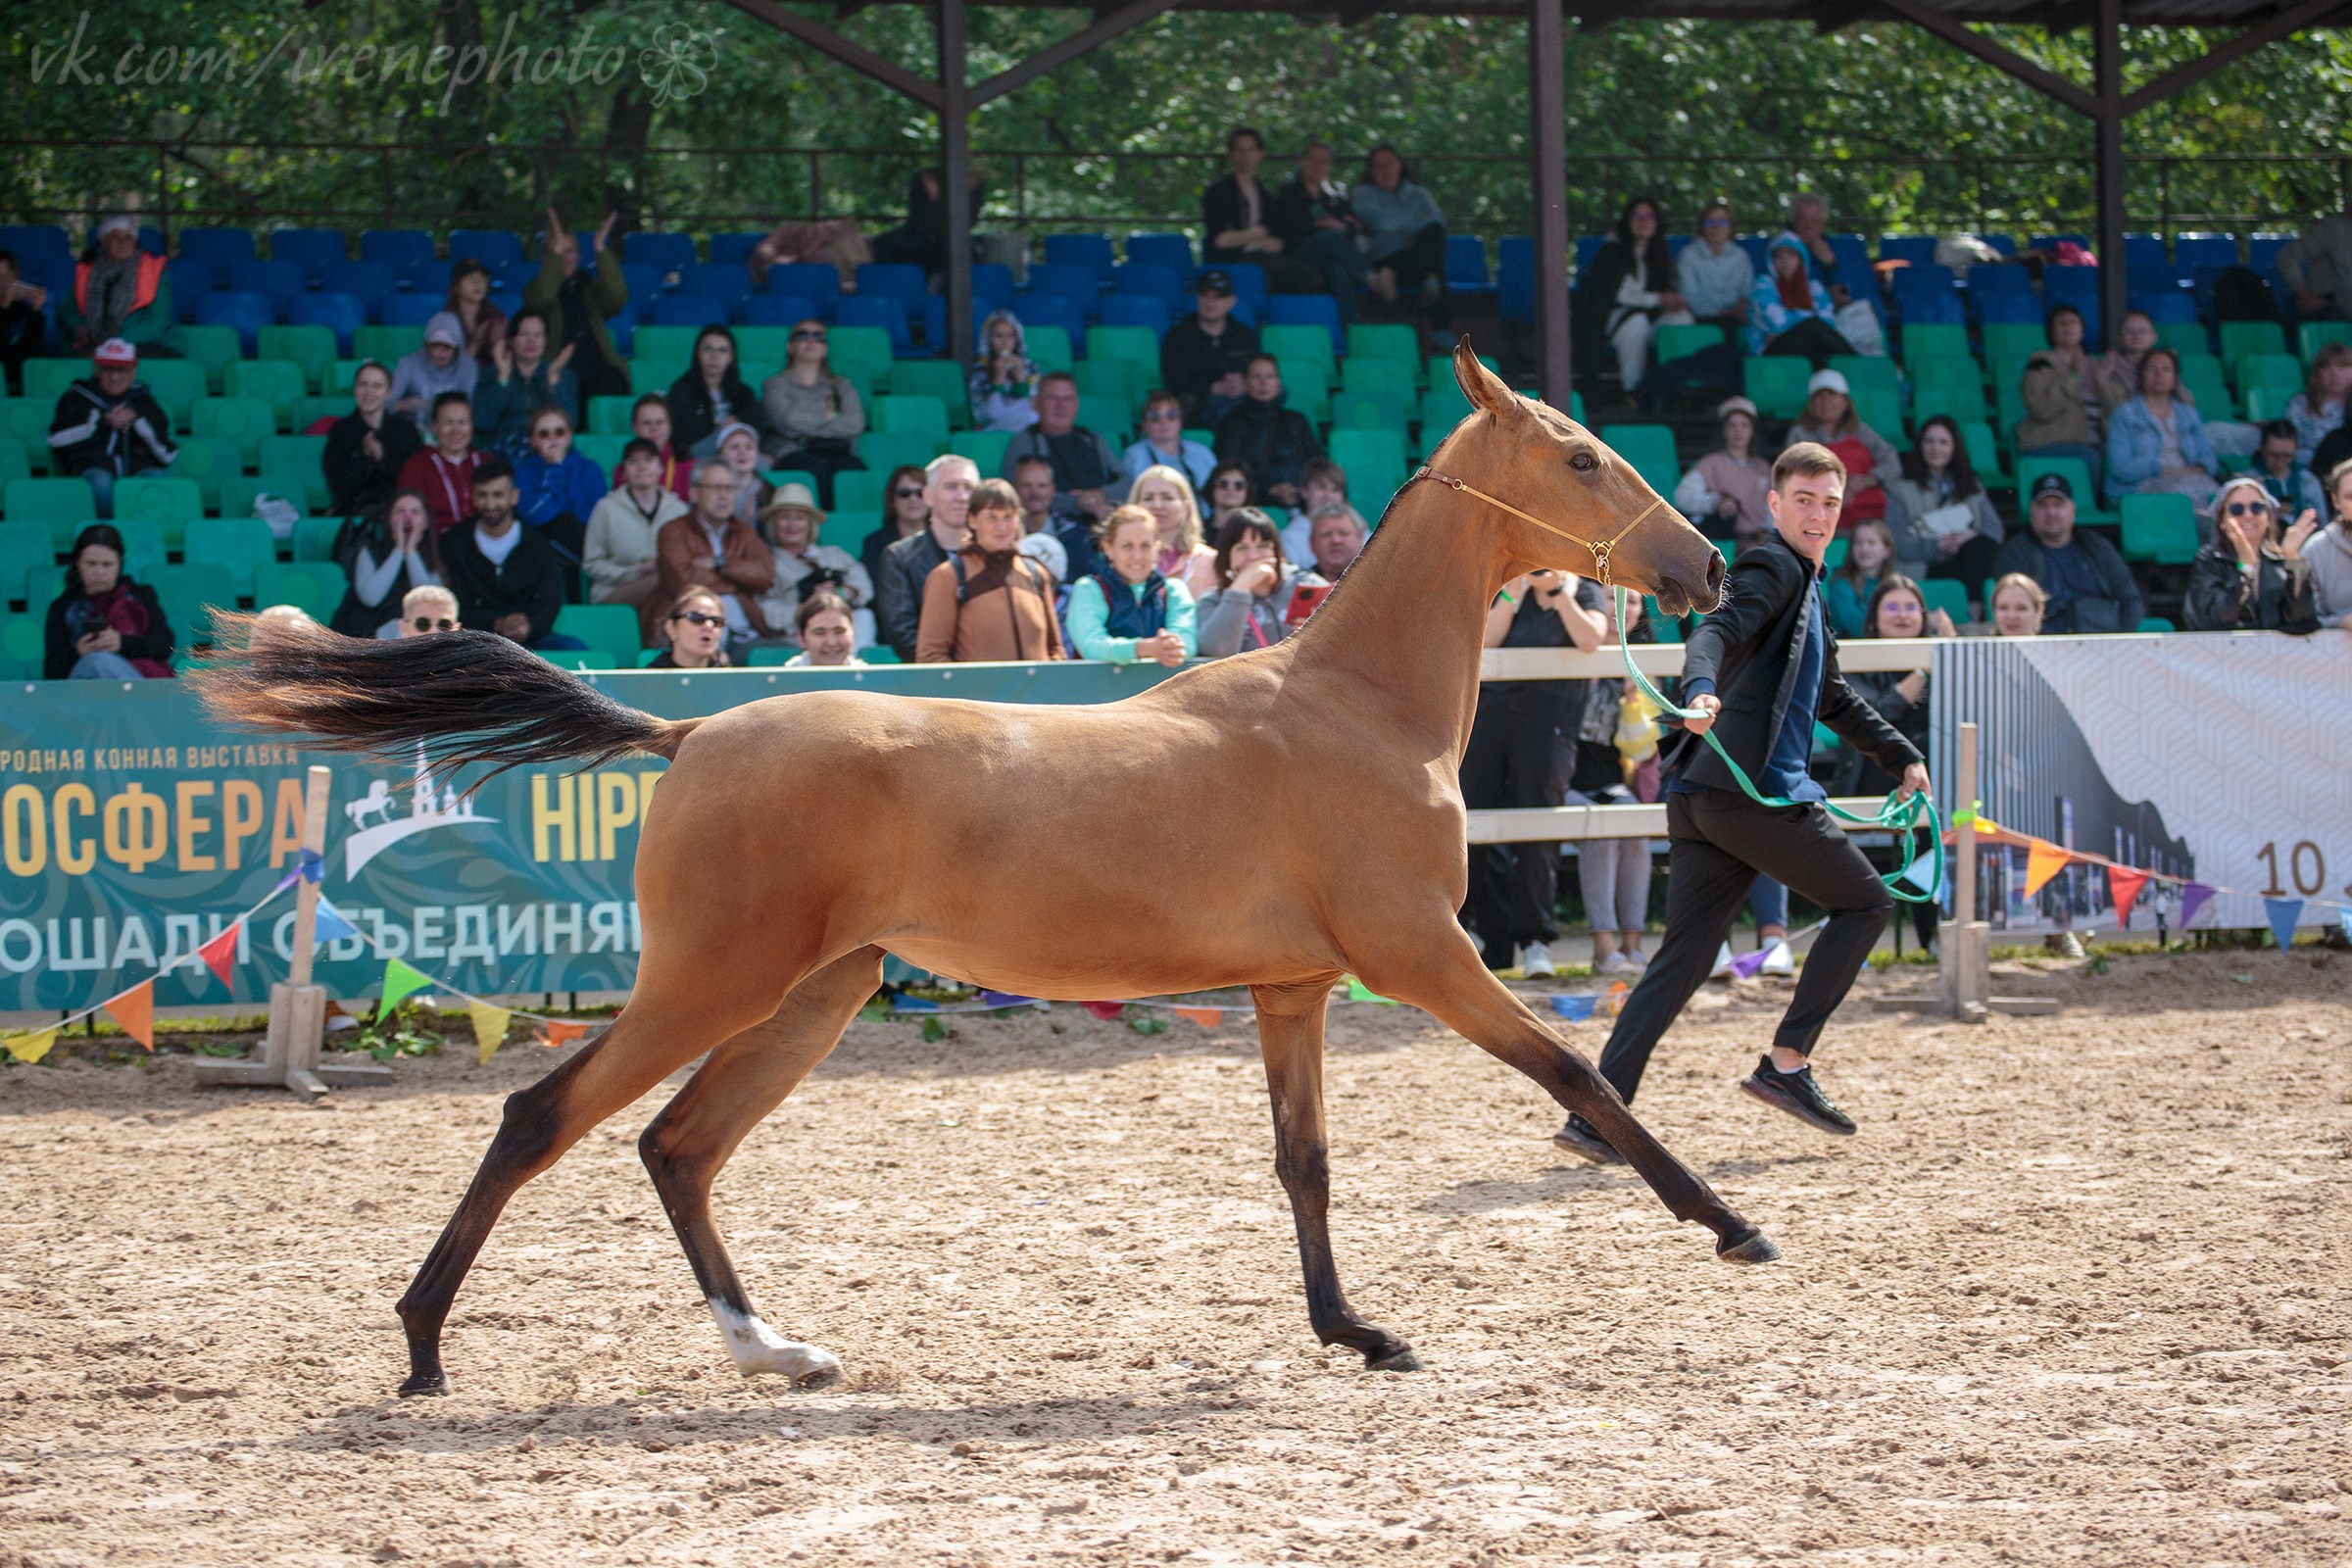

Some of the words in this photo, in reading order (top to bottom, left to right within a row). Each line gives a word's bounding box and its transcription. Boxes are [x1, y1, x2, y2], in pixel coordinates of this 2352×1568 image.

[0, 749, 86, 774] РОДНАЯ
[95, 747, 177, 770] КОННАЯ
[186, 744, 298, 768] ВЫСТАВКА
[2, 778, 305, 877] ОСФЕРА
[2257, 840, 2326, 897] 10
